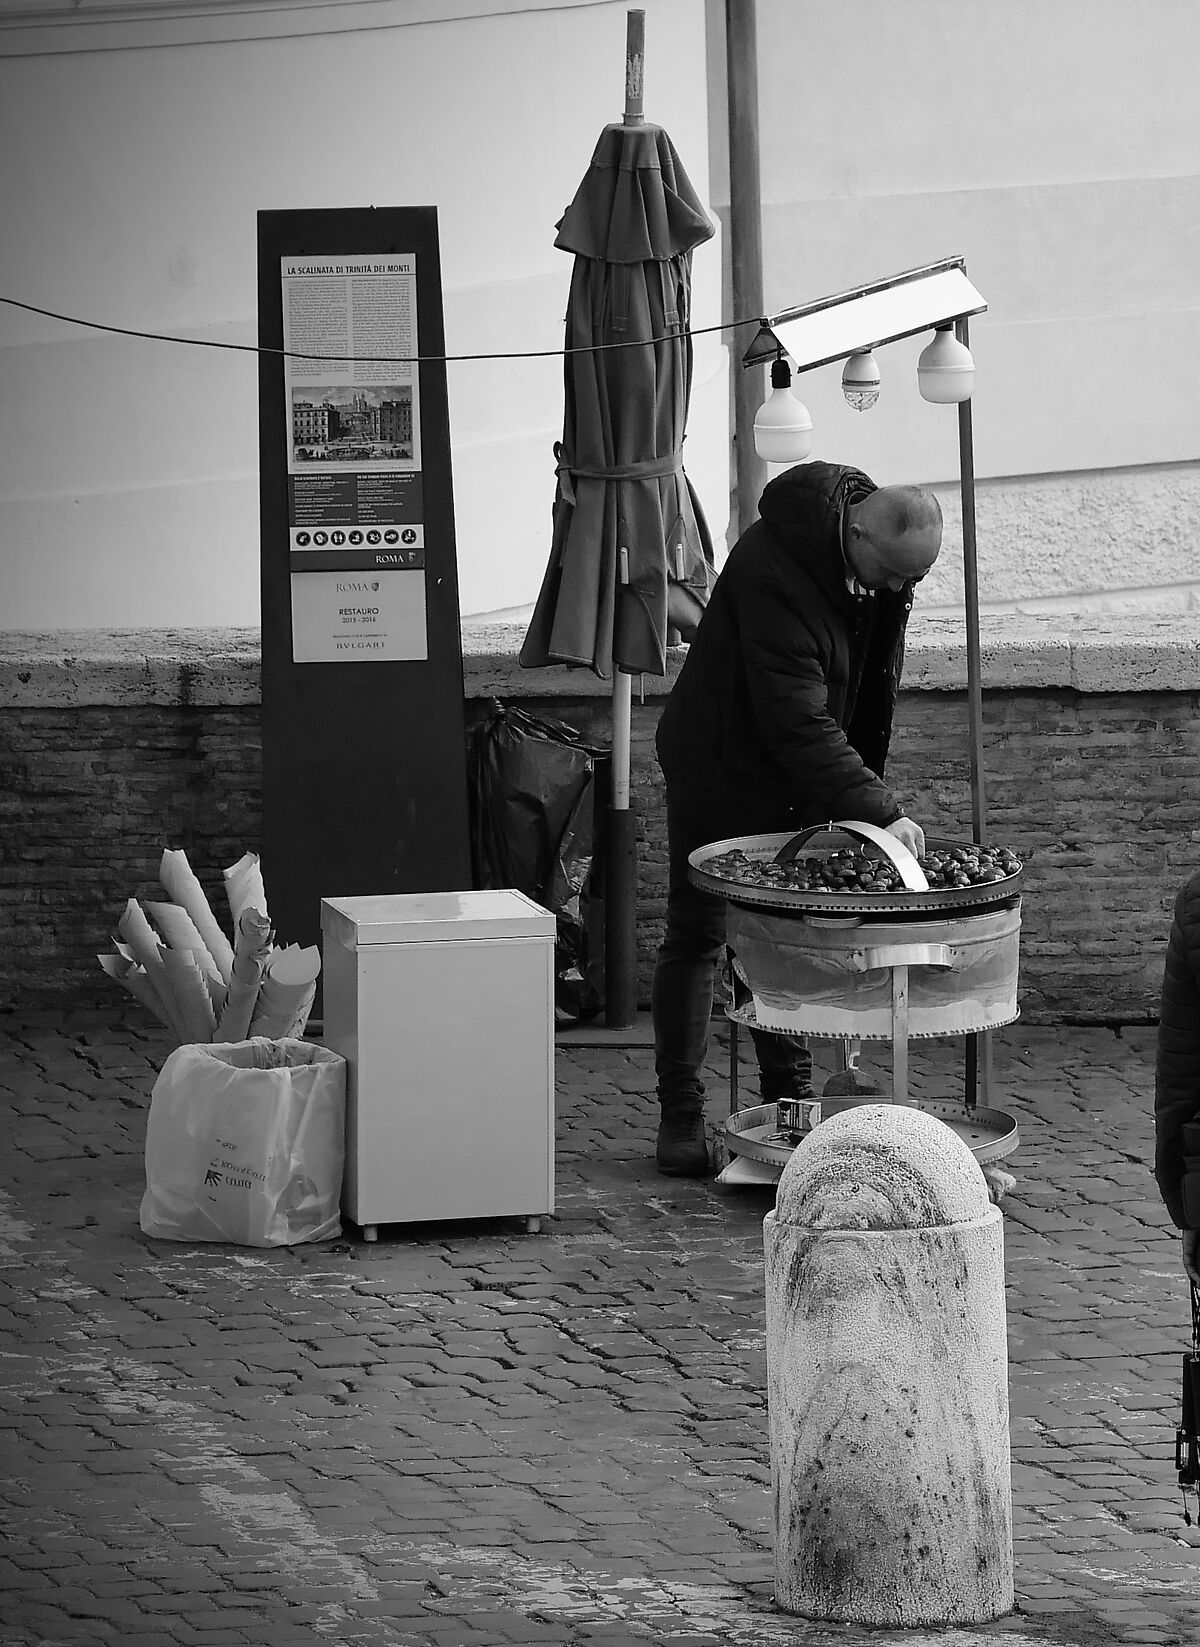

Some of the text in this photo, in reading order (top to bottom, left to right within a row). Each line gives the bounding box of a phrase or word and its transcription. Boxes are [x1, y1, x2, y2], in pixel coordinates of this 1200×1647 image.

[287, 267, 296, 275] LA
[297, 266, 334, 275] SCALINATA
[336, 266, 343, 274] DI
[373, 265, 385, 273] DEI
[387, 264, 410, 273] MONTI
[375, 554, 404, 564] ROMA
[336, 582, 369, 592] ROMA
[339, 607, 379, 616] RESTAURO
[336, 641, 385, 650] BVLGARI
